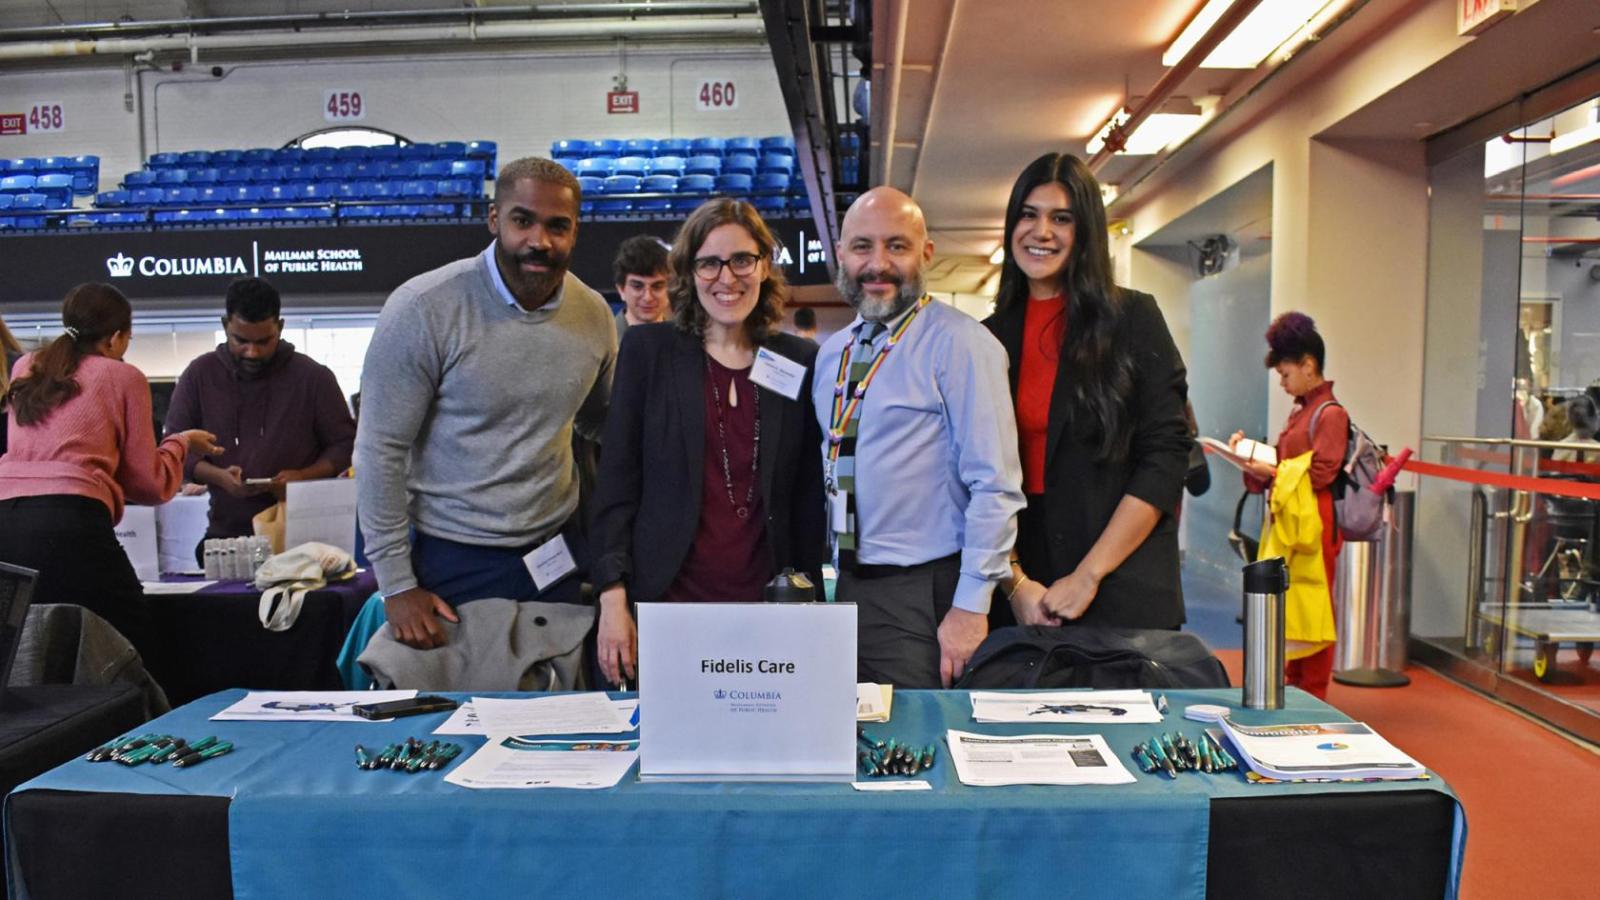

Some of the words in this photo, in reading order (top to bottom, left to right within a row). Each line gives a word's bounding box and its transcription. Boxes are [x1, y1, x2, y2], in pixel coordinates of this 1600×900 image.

[700, 81, 735, 106] 460
[327, 92, 361, 117] 459
[612, 95, 634, 106] EXIT
[2, 117, 22, 128] EXIT
[30, 104, 62, 129] 458
[264, 250, 315, 261] MAILMAN
[316, 249, 361, 260] SCHOOL
[139, 256, 247, 277] COLUMBIA
[281, 261, 318, 272] PUBLIC
[320, 260, 363, 271] HEALTH
[701, 659, 753, 674] Fidelis
[757, 659, 796, 674] Care
[729, 690, 782, 700] COLUMBIA
